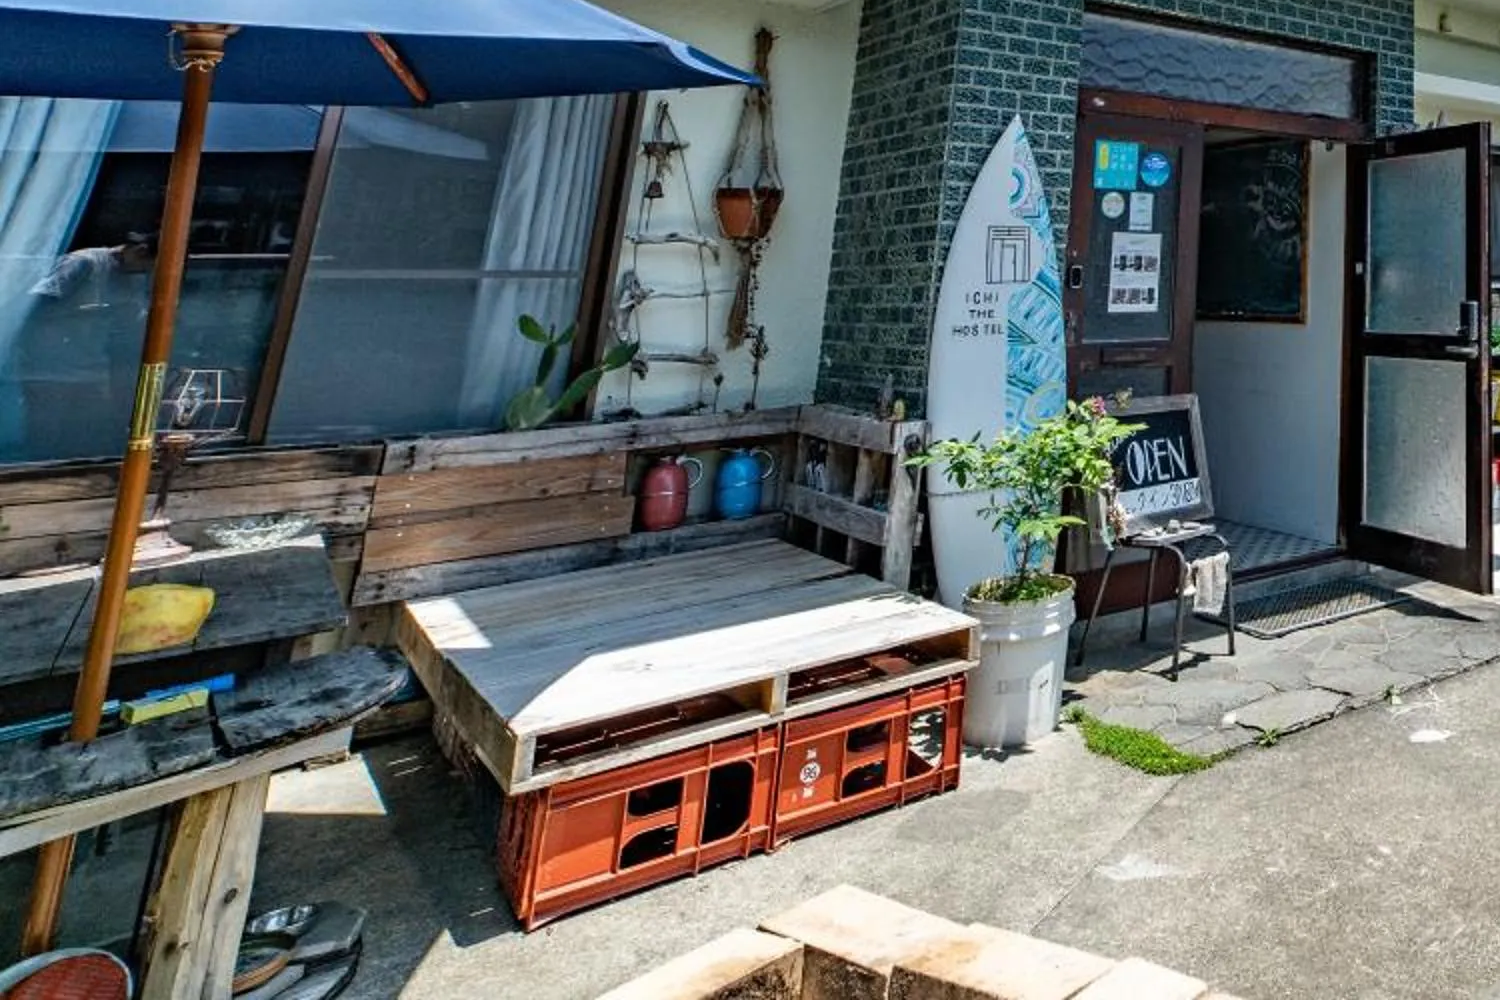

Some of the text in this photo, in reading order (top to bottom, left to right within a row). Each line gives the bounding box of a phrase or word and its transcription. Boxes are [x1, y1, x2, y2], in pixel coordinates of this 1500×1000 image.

[965, 291, 999, 304] ICHI
[968, 309, 995, 318] THE
[952, 323, 1004, 336] HOSTEL
[1126, 436, 1188, 485] OPEN
